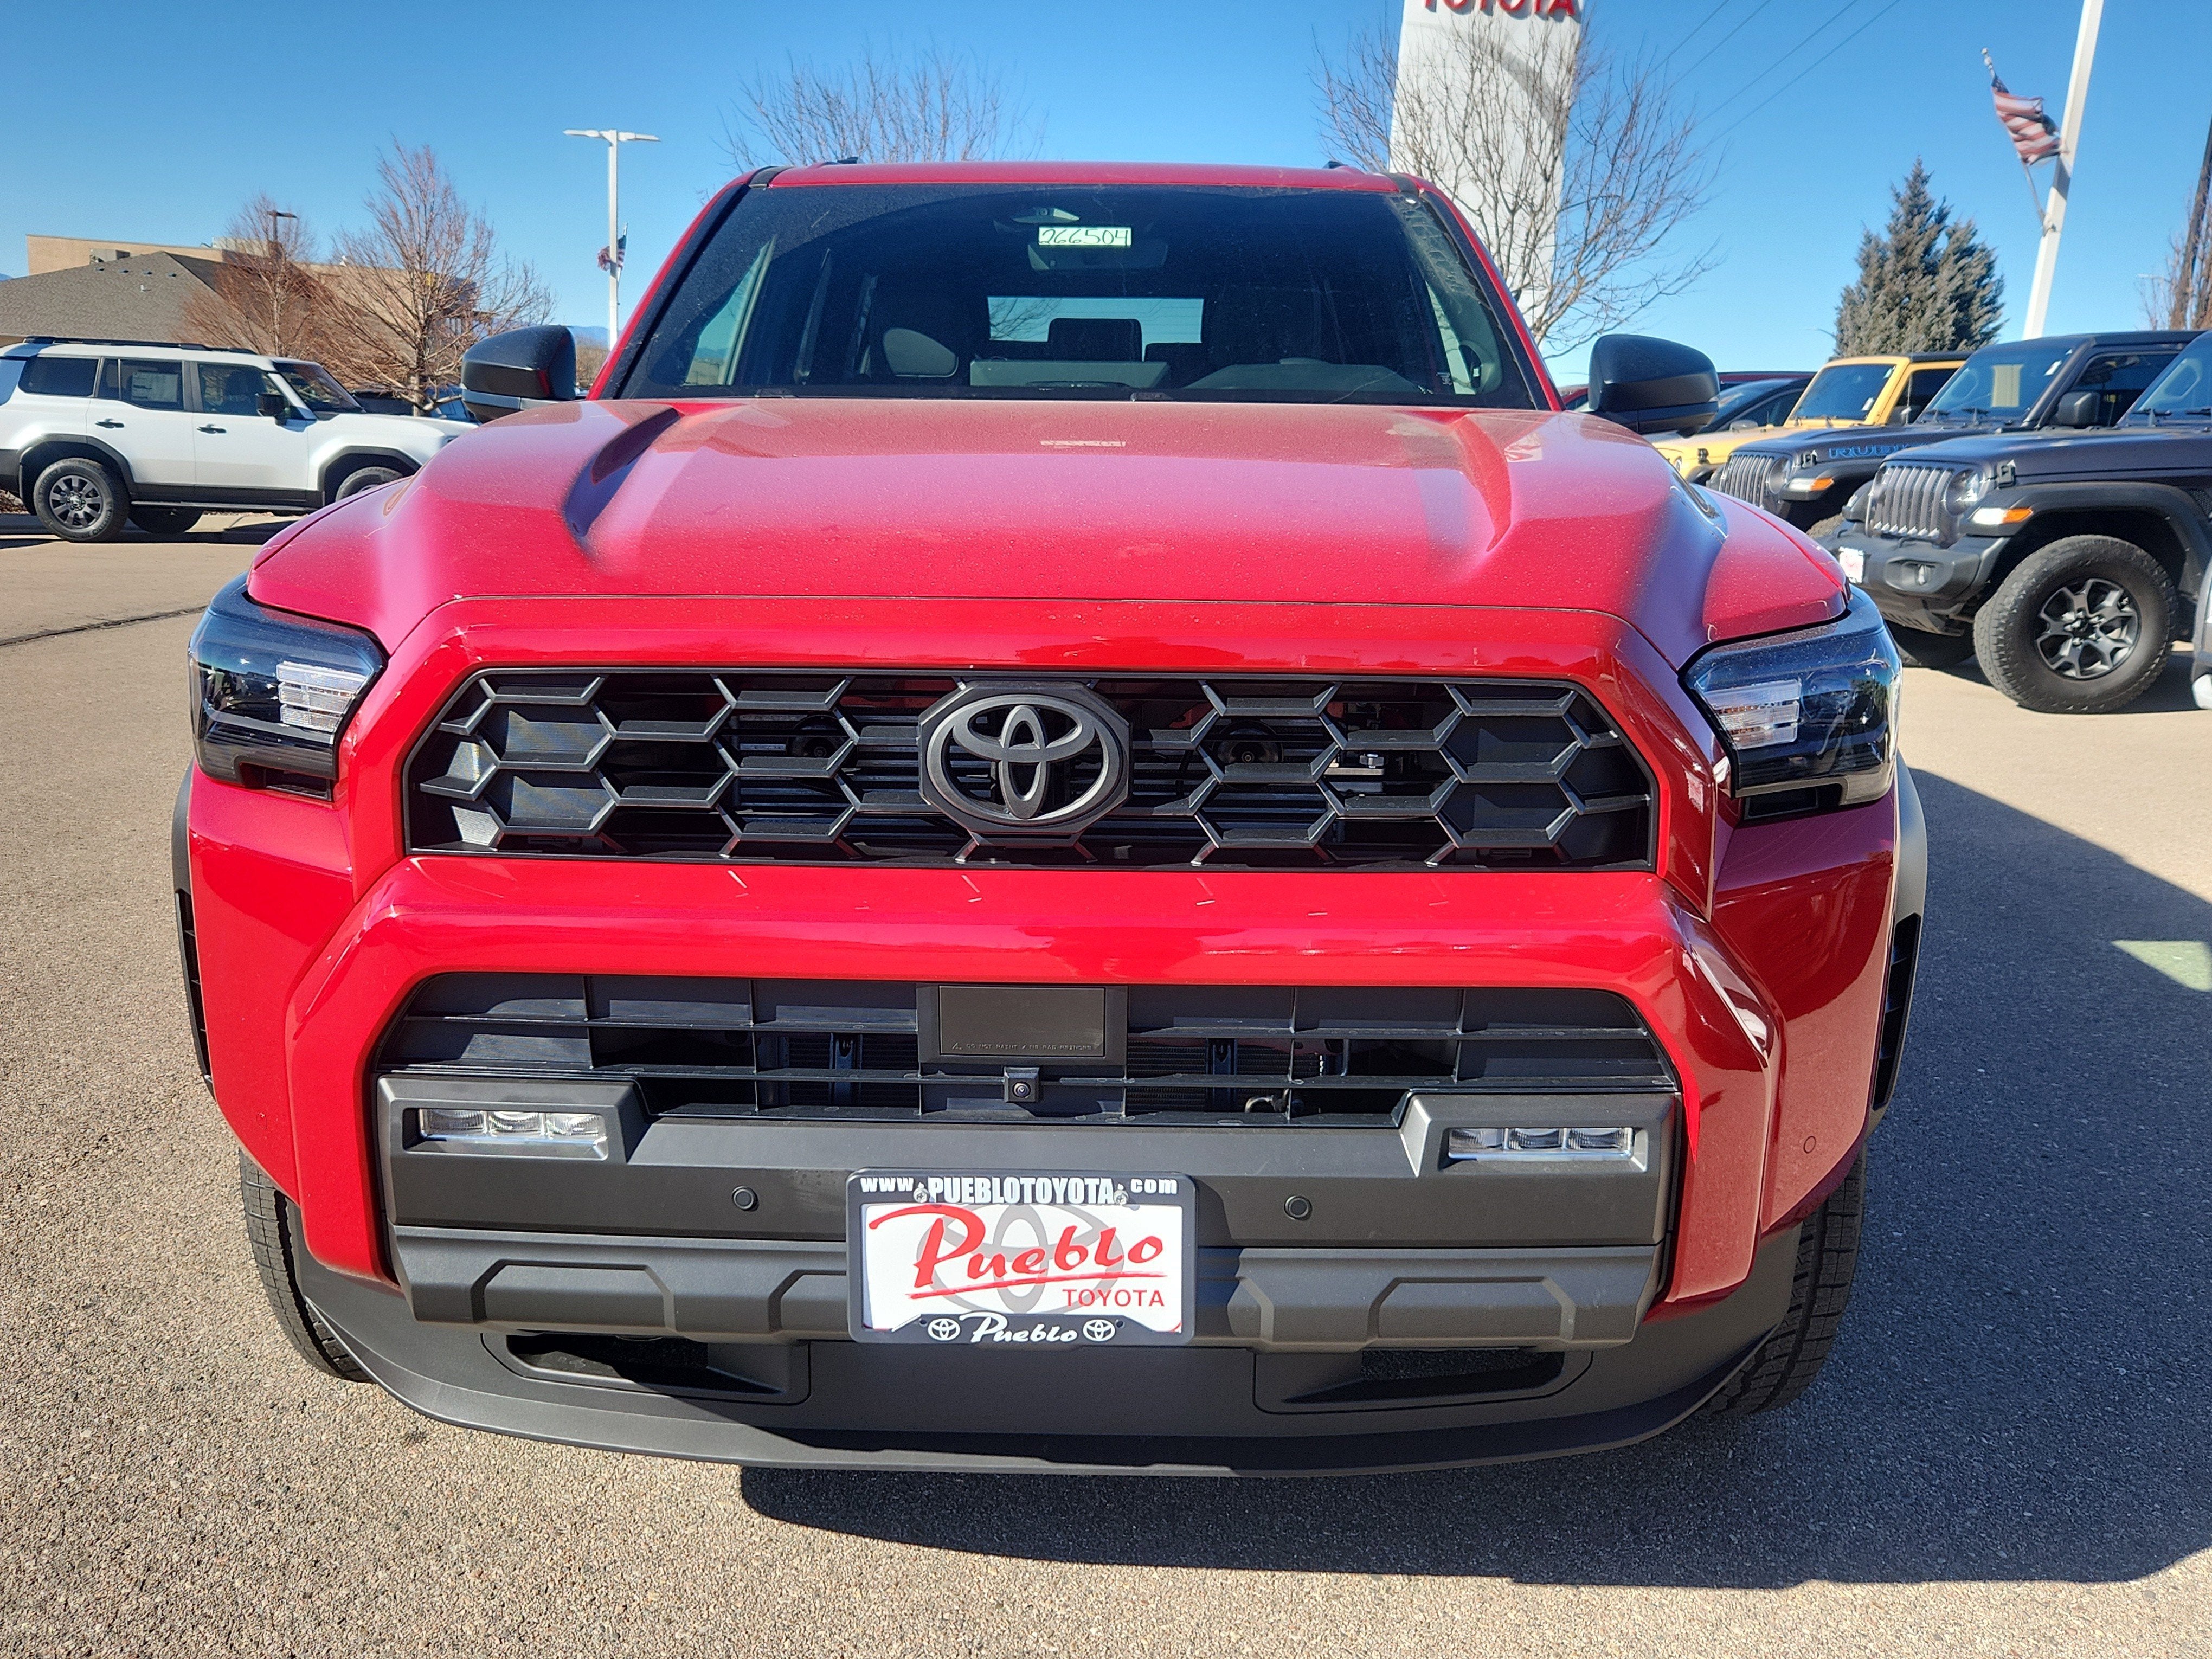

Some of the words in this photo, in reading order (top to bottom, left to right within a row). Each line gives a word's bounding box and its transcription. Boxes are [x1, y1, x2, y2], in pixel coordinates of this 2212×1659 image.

[1039, 229, 1128, 246] 266504
[869, 1203, 1163, 1288] Pueblo
[1062, 1288, 1165, 1307] TOYOTA
[959, 1310, 1078, 1343] Pueblo
